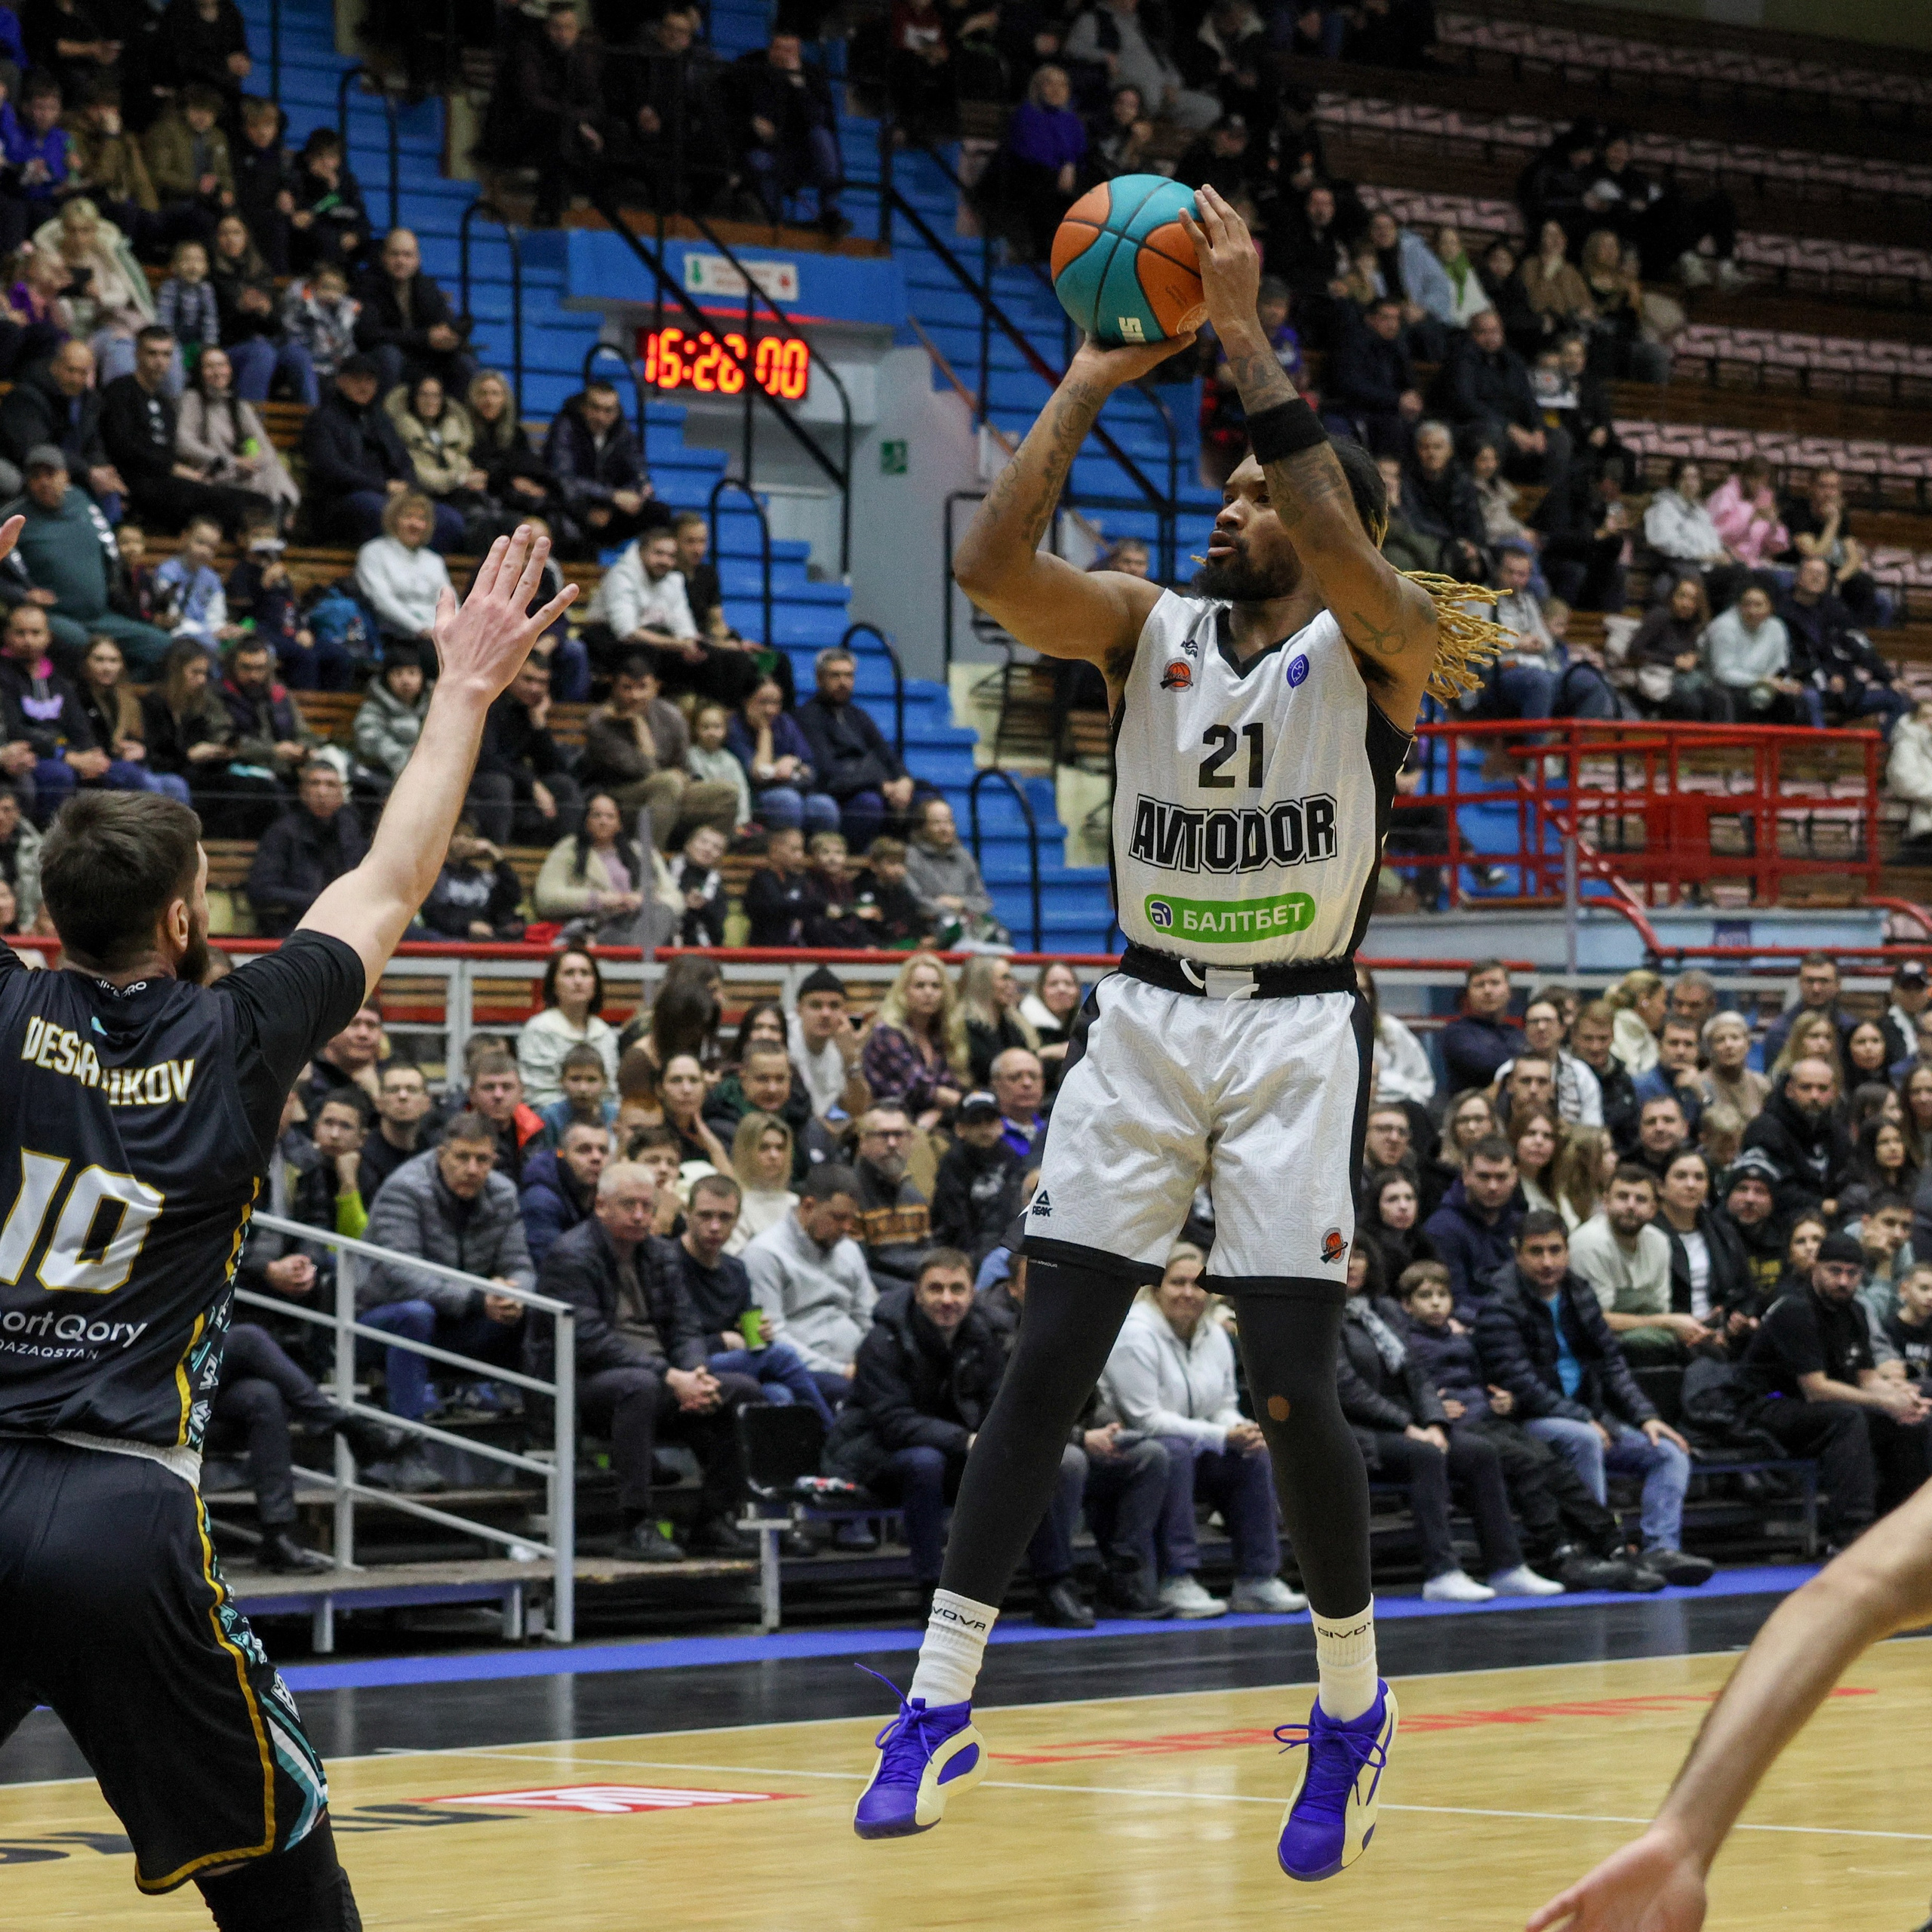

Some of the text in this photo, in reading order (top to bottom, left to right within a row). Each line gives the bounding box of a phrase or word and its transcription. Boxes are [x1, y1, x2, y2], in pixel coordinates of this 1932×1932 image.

[1198, 722, 1264, 789] 21
[1128, 792, 1337, 874] AVTODOR
[1183, 902, 1306, 933] БАЛТБЕТ
[0, 1146, 165, 1294] 10
[1032, 1206, 1053, 1217] PEAK
[0, 1312, 148, 1348] ortQory
[933, 1606, 986, 1632] VOVA
[1318, 1620, 1372, 1638] GIVO
